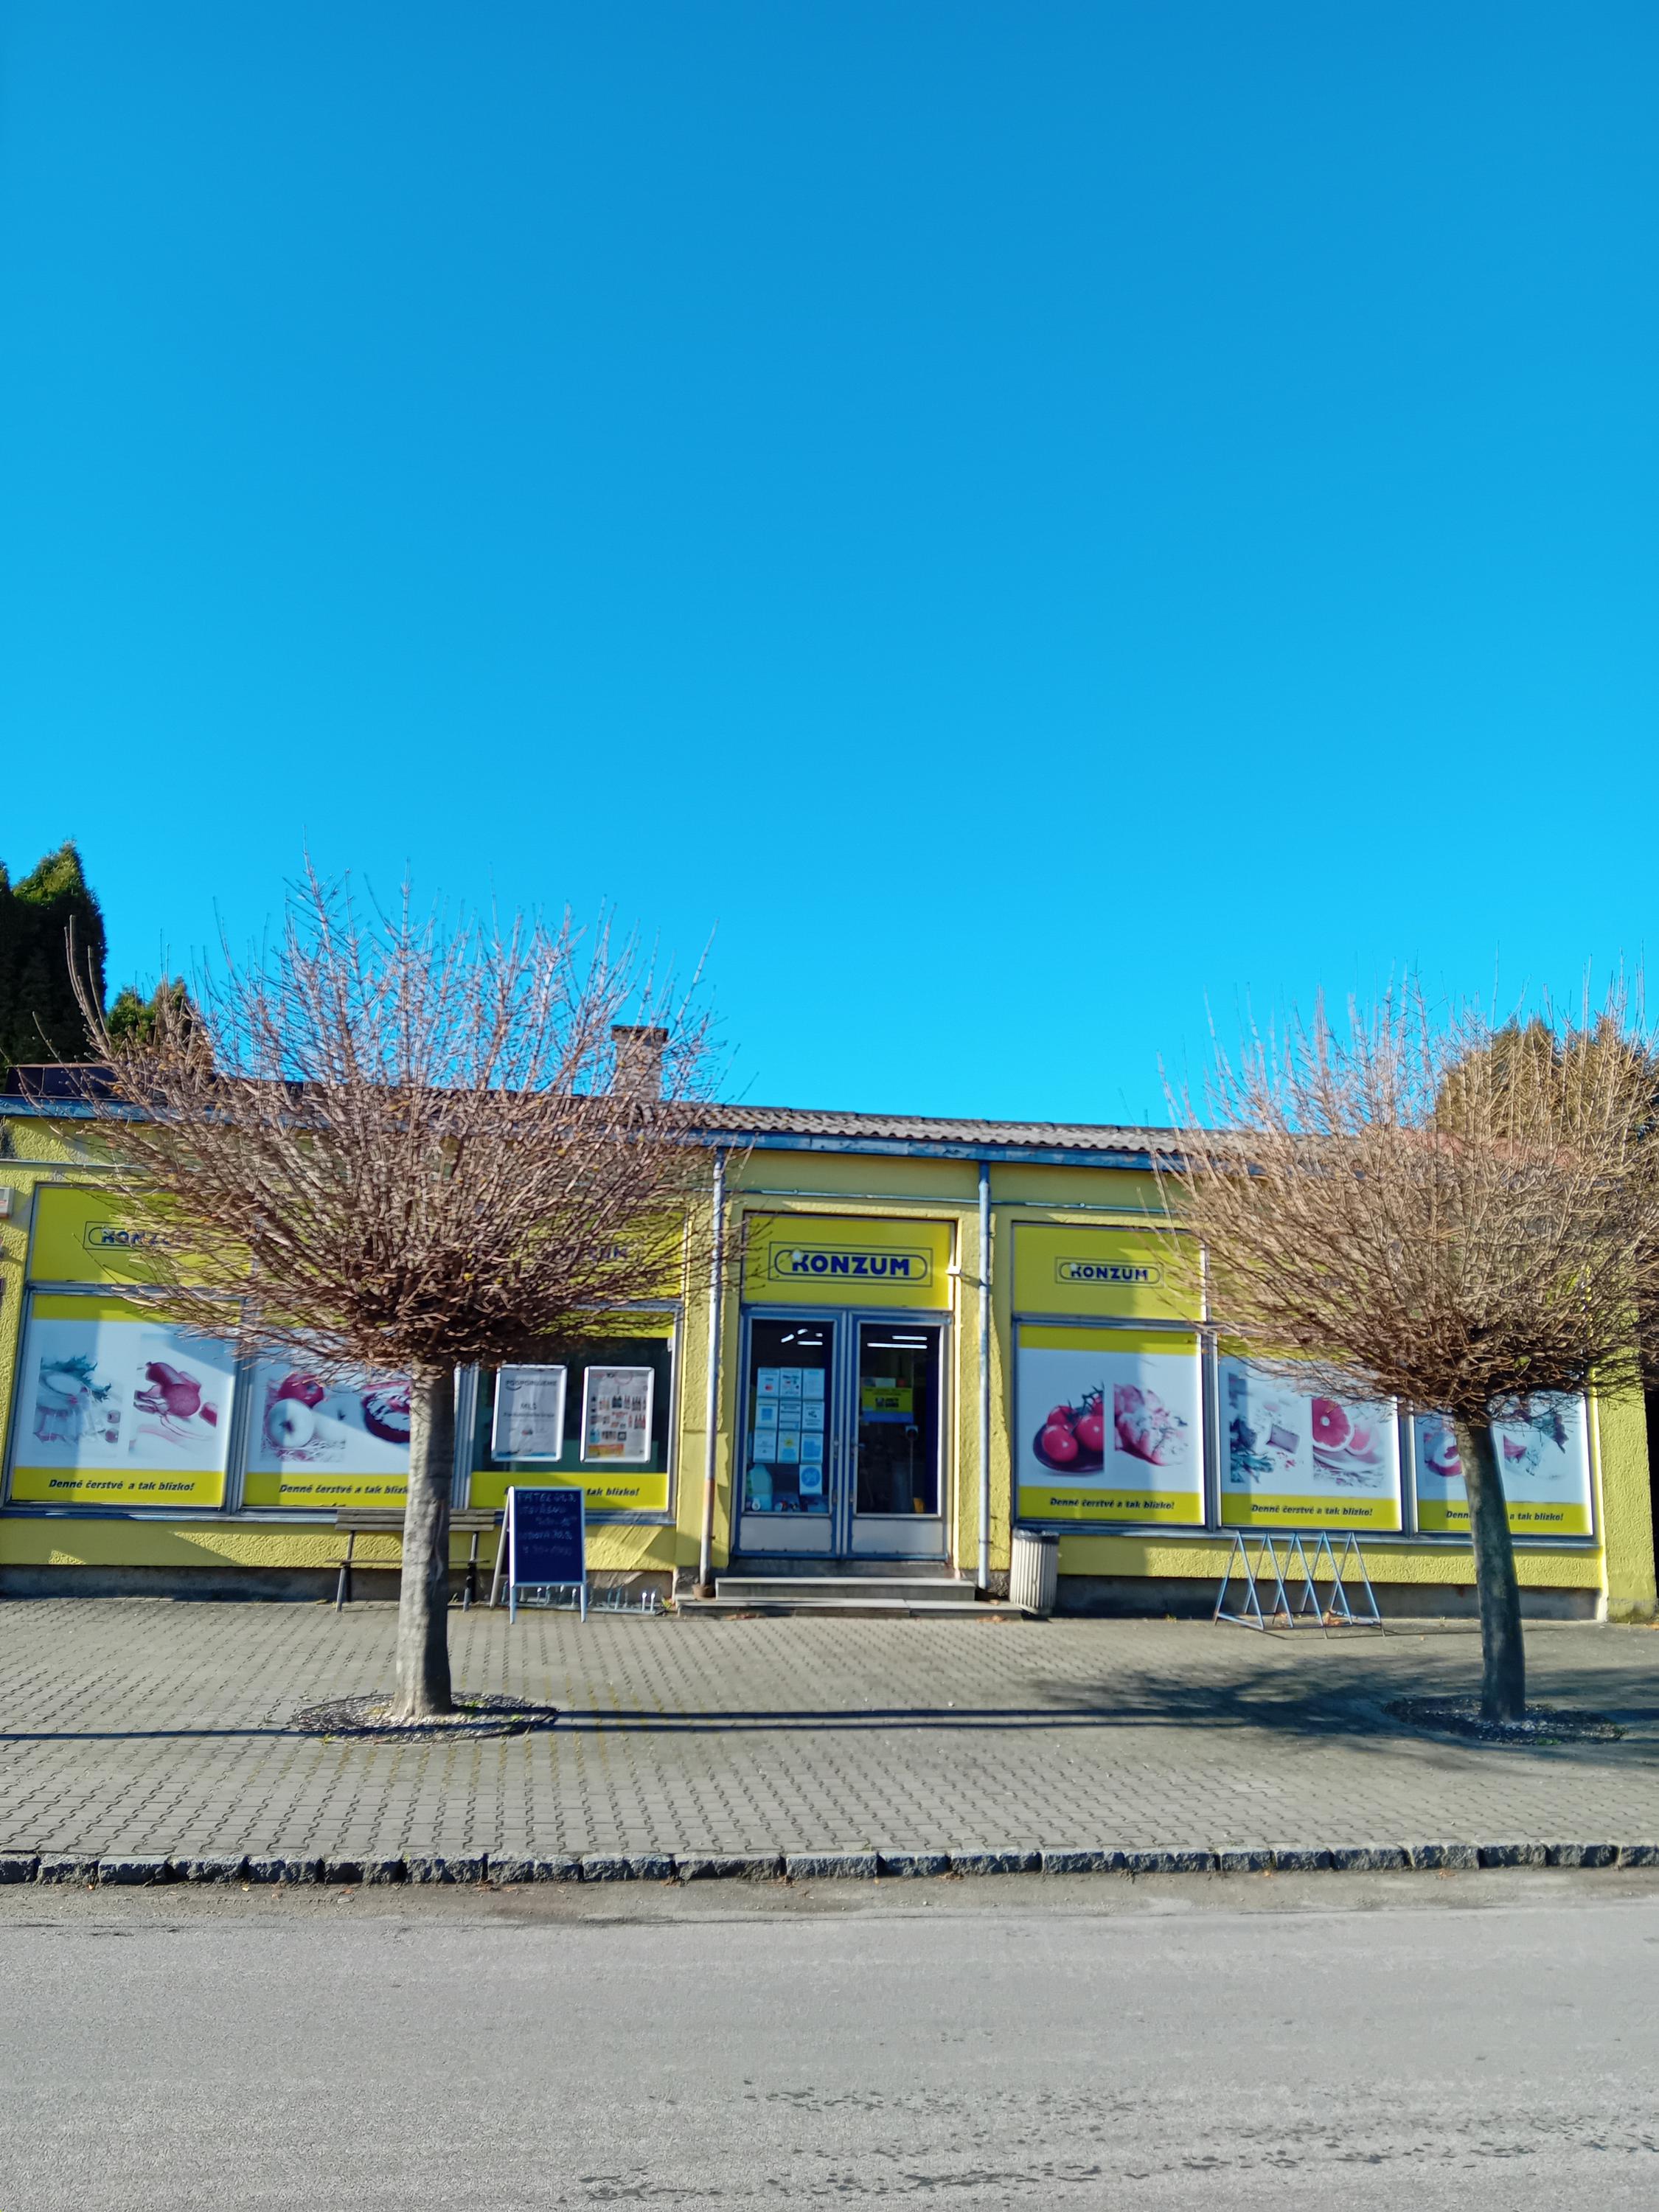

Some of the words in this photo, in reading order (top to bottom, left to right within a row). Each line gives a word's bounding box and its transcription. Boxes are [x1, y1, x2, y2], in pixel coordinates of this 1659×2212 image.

[101, 1229, 173, 1248] KONZ
[792, 1254, 909, 1276] KONZUM
[1071, 1266, 1148, 1281] KONZUM
[86, 1481, 123, 1490] čerstvé
[138, 1482, 156, 1490] tak
[158, 1482, 195, 1491] blízko!
[316, 1484, 352, 1494] čerstvé
[364, 1486, 381, 1494] tak
[384, 1486, 408, 1495] blízk
[587, 1488, 604, 1496] tak
[606, 1487, 639, 1497] blízko!
[1082, 1498, 1114, 1508] čerstvé
[1126, 1500, 1141, 1509] tak
[1144, 1501, 1175, 1509] blízko!
[1283, 1505, 1315, 1514] čerstvé
[1326, 1507, 1340, 1515] tak
[1343, 1508, 1373, 1516] blízko!
[1446, 1511, 1471, 1519] Denn
[1517, 1512, 1531, 1520] tak
[1534, 1512, 1563, 1521] blízko!
